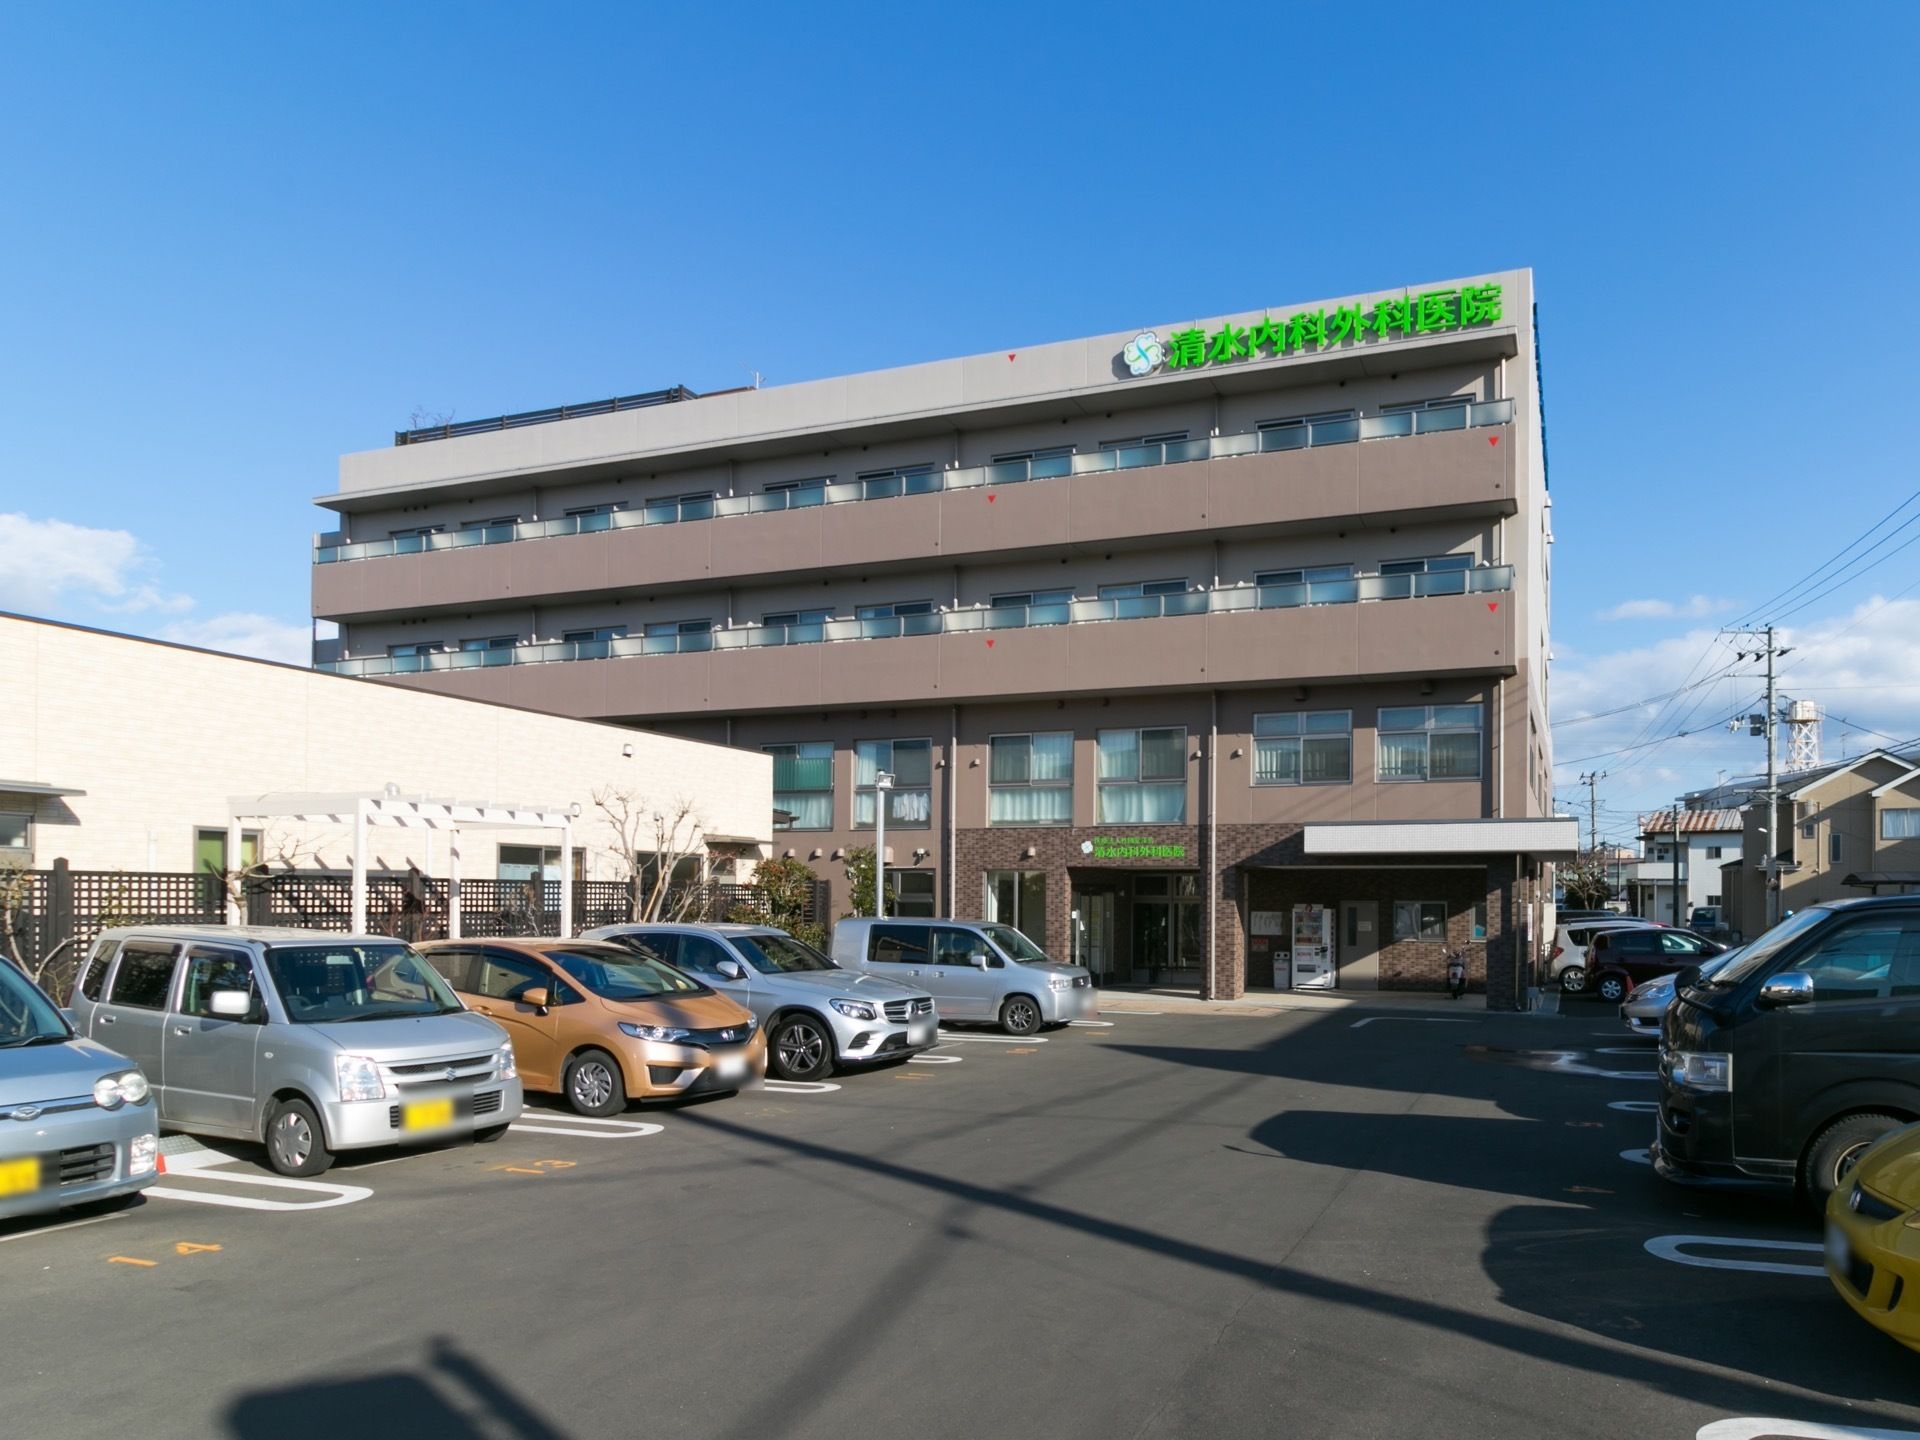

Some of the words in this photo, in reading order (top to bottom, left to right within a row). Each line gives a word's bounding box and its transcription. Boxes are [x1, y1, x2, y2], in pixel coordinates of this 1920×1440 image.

[1168, 283, 1502, 368] 清水内科外科医院
